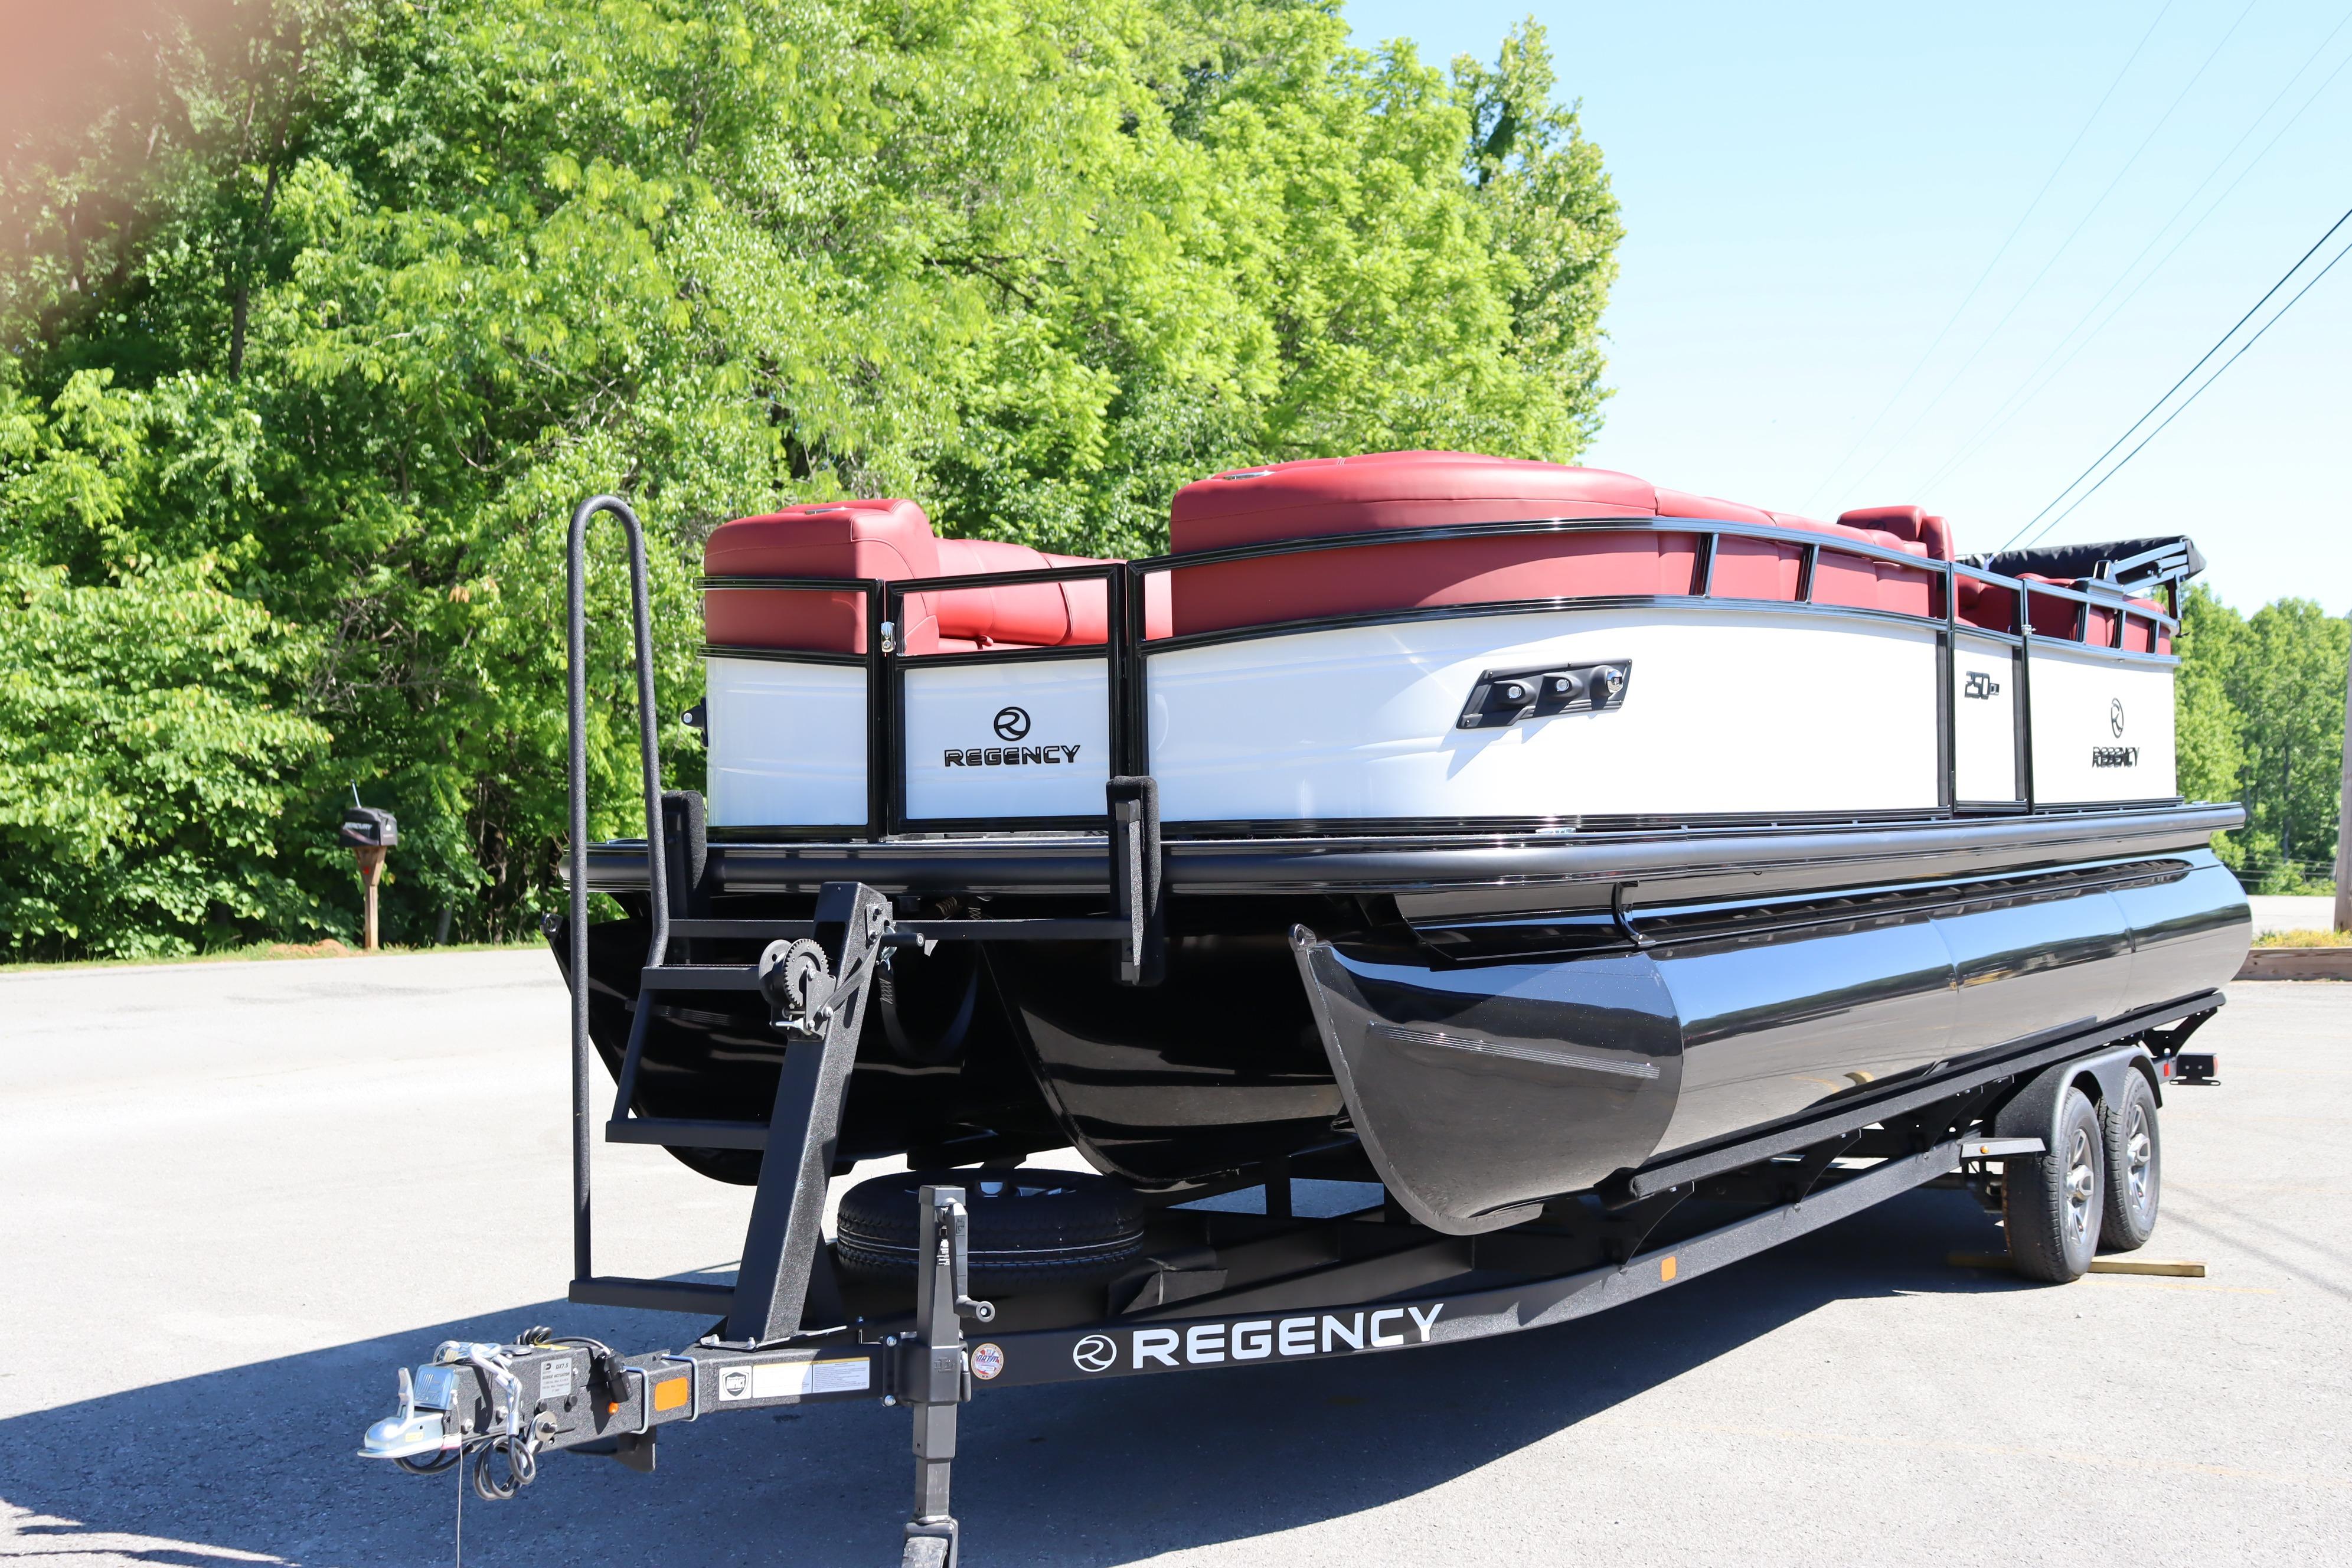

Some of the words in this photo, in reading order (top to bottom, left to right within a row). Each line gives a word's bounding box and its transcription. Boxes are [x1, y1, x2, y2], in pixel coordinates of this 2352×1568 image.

[944, 744, 1081, 767] REGENCY
[2092, 746, 2139, 768] REGENCY
[1132, 1303, 1444, 1369] REGENCY
